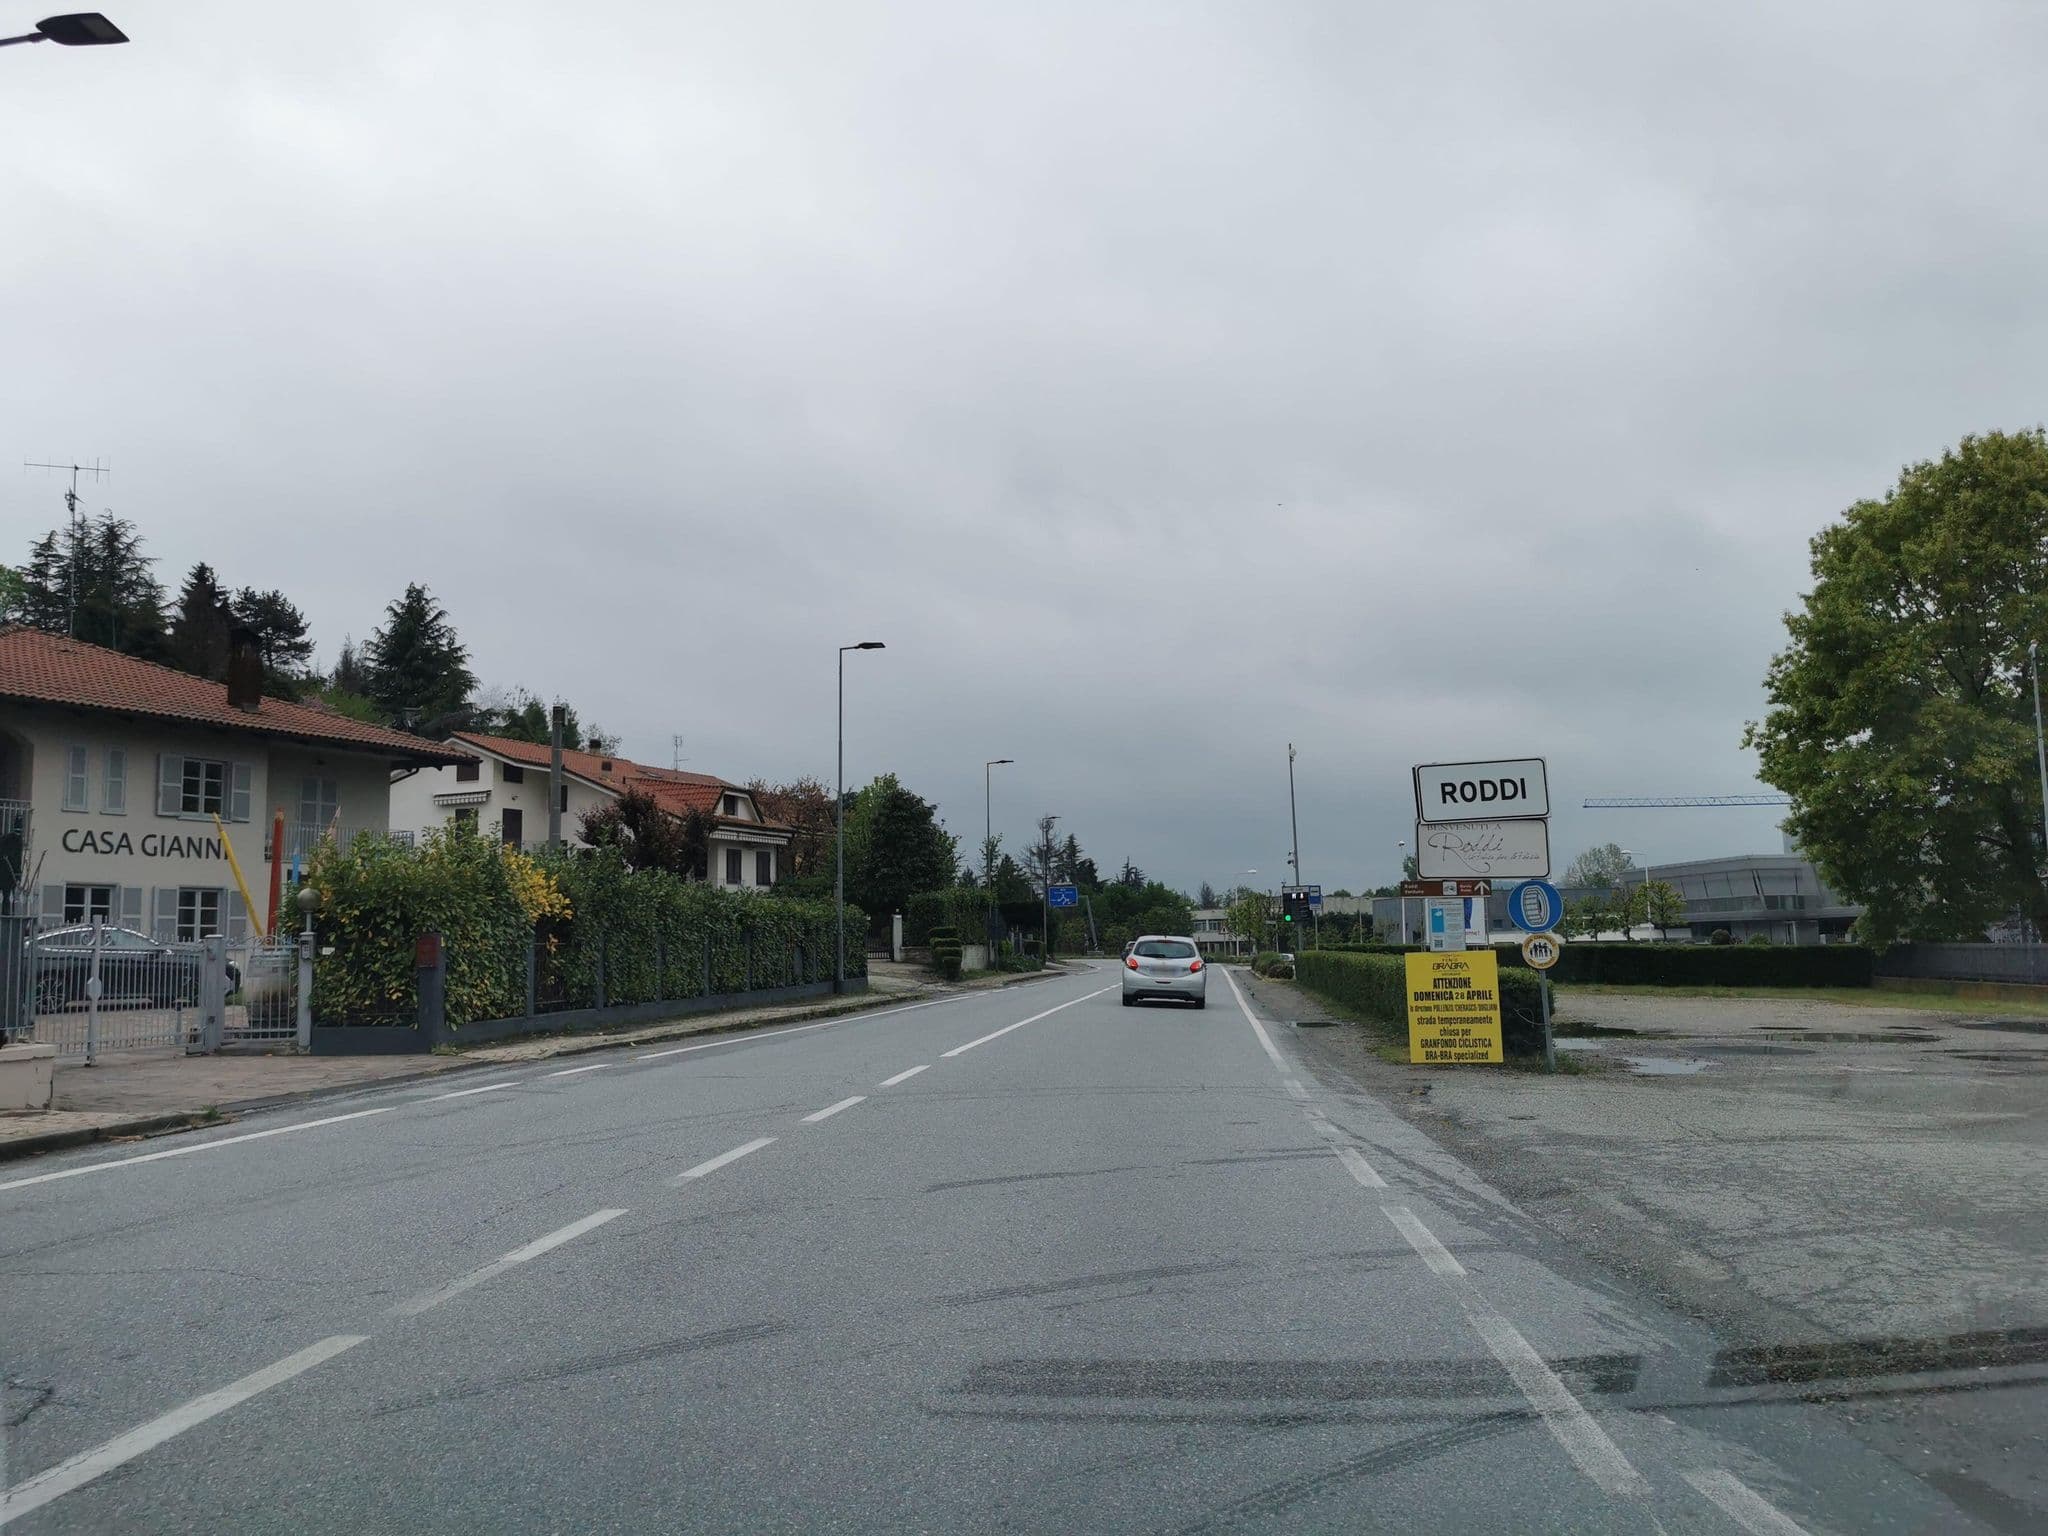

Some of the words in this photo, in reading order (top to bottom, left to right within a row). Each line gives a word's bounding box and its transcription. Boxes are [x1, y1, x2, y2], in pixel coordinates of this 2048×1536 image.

[1440, 778, 1526, 804] RODDI
[1427, 823, 1488, 831] BENVENUTI
[62, 829, 134, 856] CASA
[1428, 832, 1503, 873] Roddi
[1433, 977, 1471, 989] ATTENZIONE
[1414, 991, 1454, 1001] DOMENICA
[1466, 990, 1493, 1000] APRILE
[1417, 1016, 1436, 1026] strada
[1437, 1015, 1493, 1027] temporaneamente
[1440, 1027, 1460, 1037] chiusa
[1461, 1028, 1472, 1037] per
[1421, 1039, 1457, 1048] GRANFONDO
[1458, 1038, 1492, 1048] CICLISTICA
[1425, 1050, 1453, 1060] BRA-BRA
[1454, 1050, 1489, 1061] specialized
